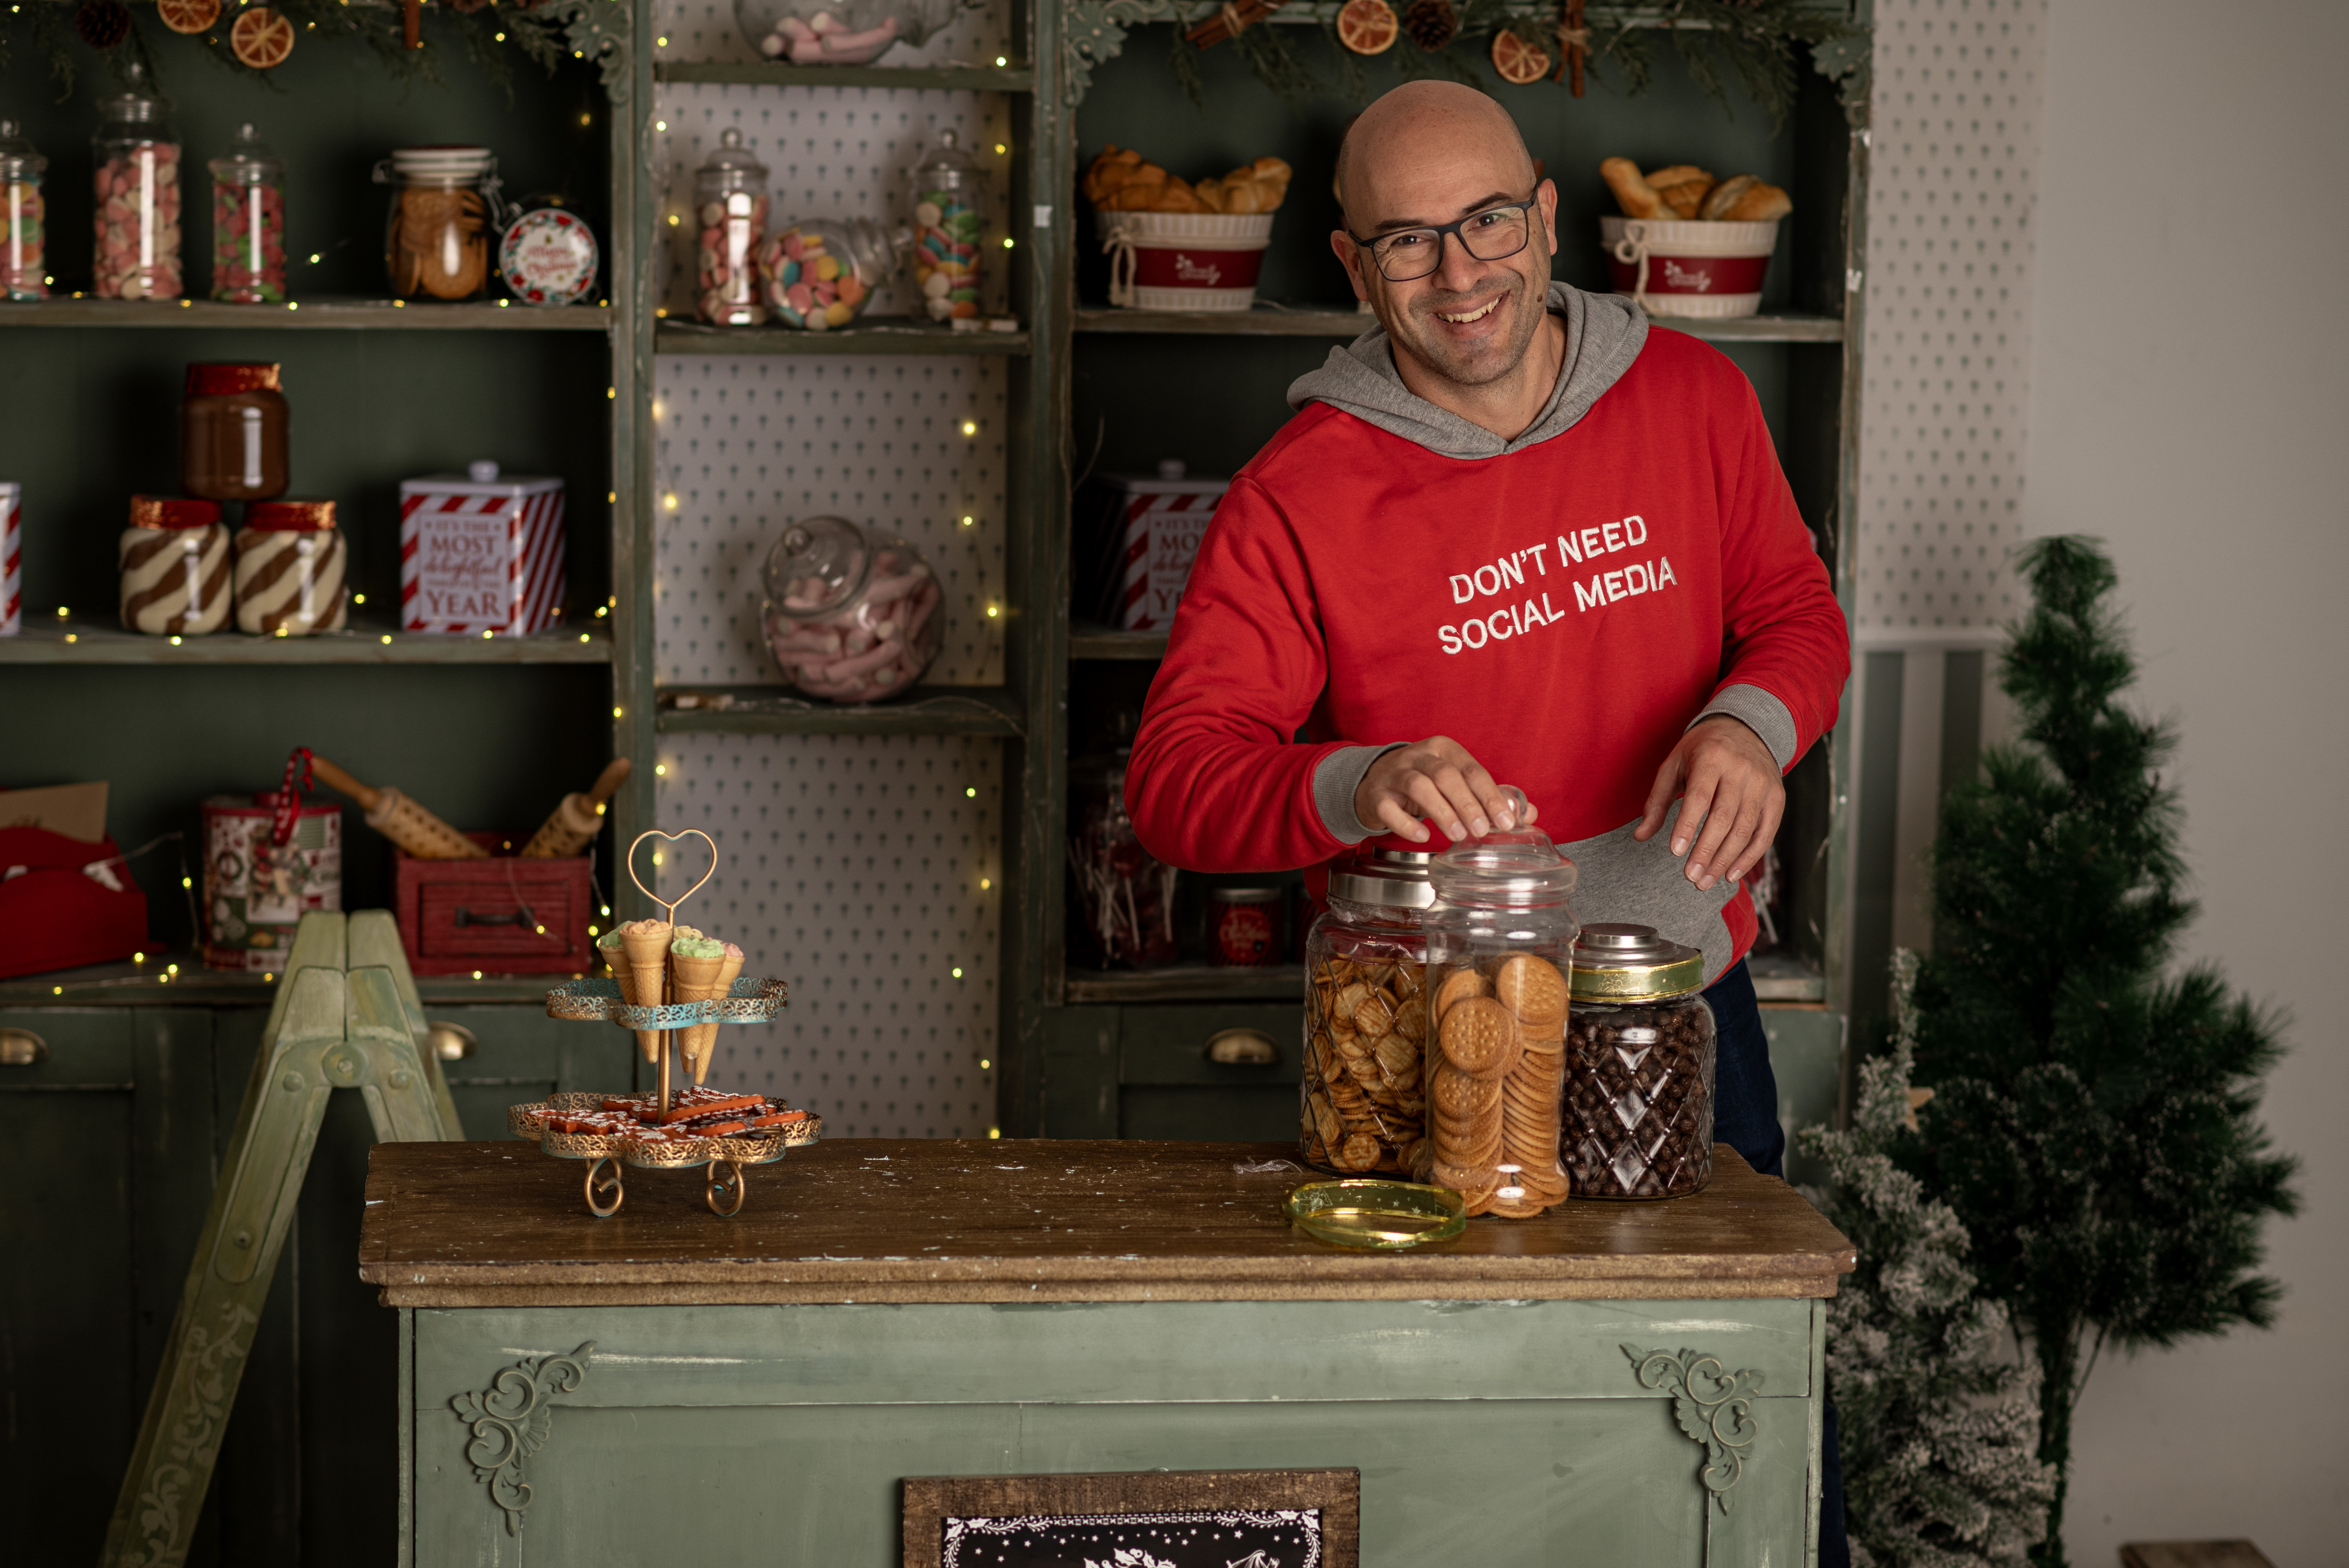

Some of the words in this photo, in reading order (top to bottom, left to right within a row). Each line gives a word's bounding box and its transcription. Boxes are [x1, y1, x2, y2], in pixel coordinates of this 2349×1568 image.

[430, 535, 497, 555] MOST
[1449, 543, 1547, 604] DON'T
[1558, 515, 1647, 567] NEED
[425, 590, 502, 618] YEAR
[1438, 593, 1565, 654] SOCIAL
[1573, 556, 1678, 612] MEDIA
